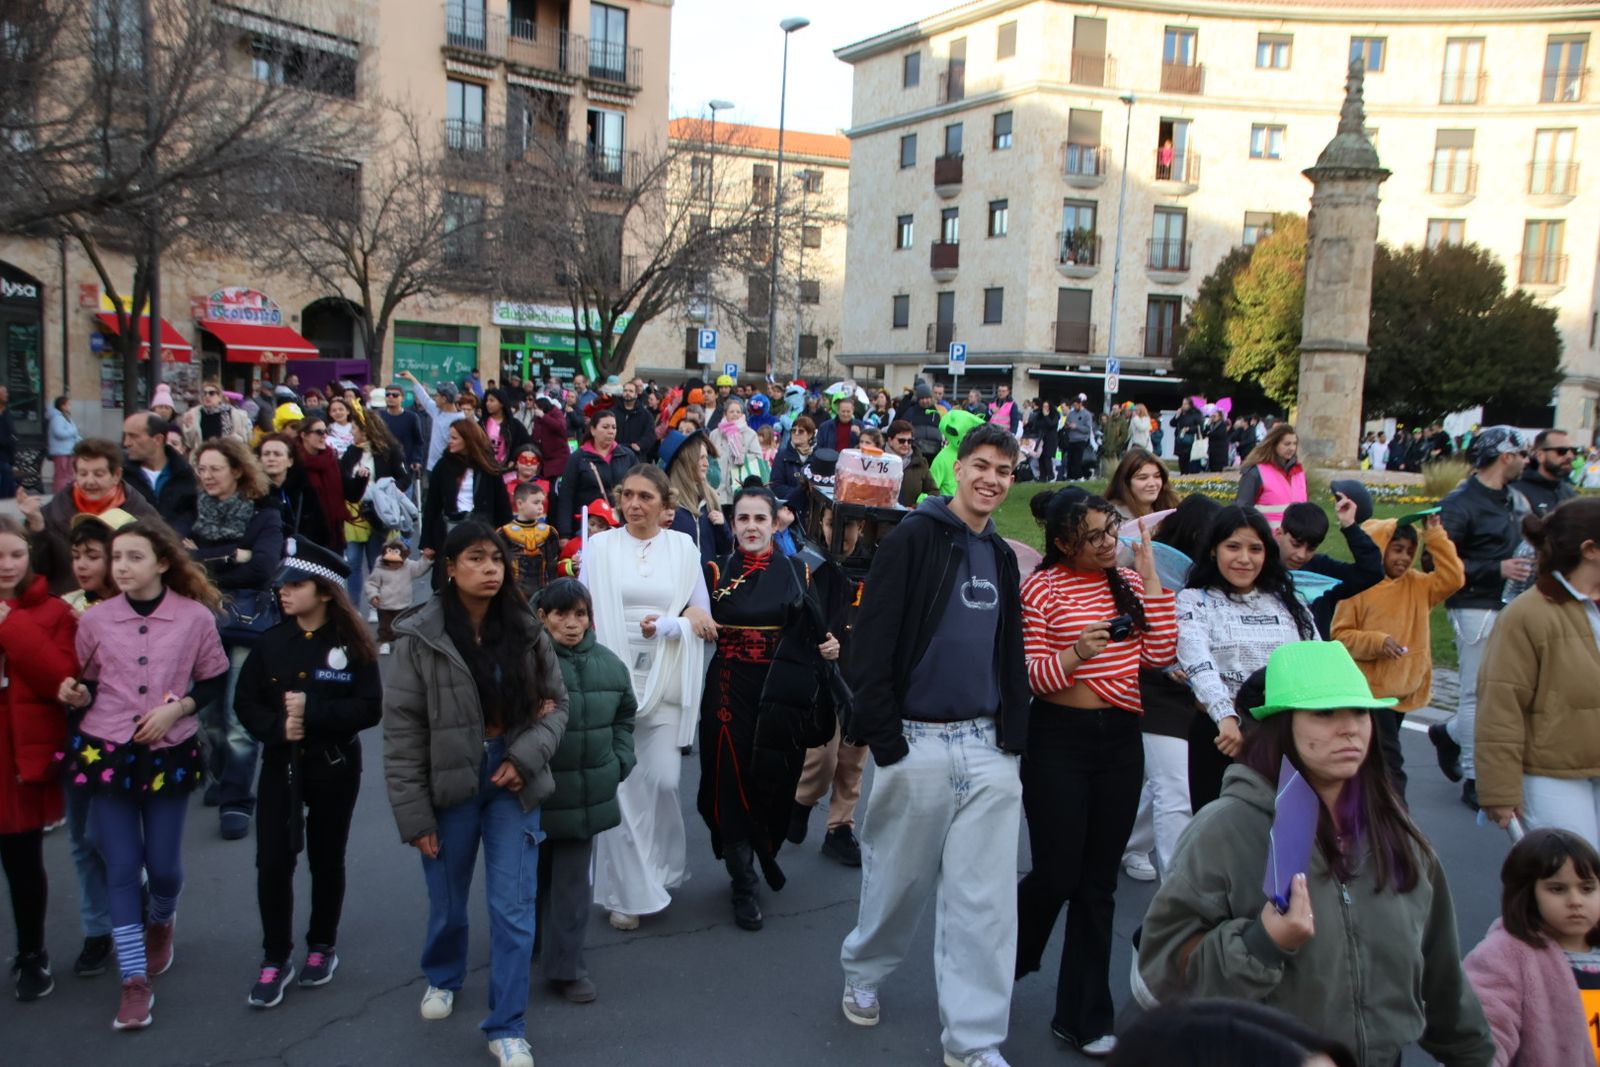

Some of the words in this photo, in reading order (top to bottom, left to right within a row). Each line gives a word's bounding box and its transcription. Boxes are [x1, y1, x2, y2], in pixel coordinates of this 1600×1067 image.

[702, 331, 714, 348] P
[953, 345, 964, 360] P
[442, 356, 453, 374] 4
[727, 365, 735, 377] P
[319, 670, 352, 681] POLICE
